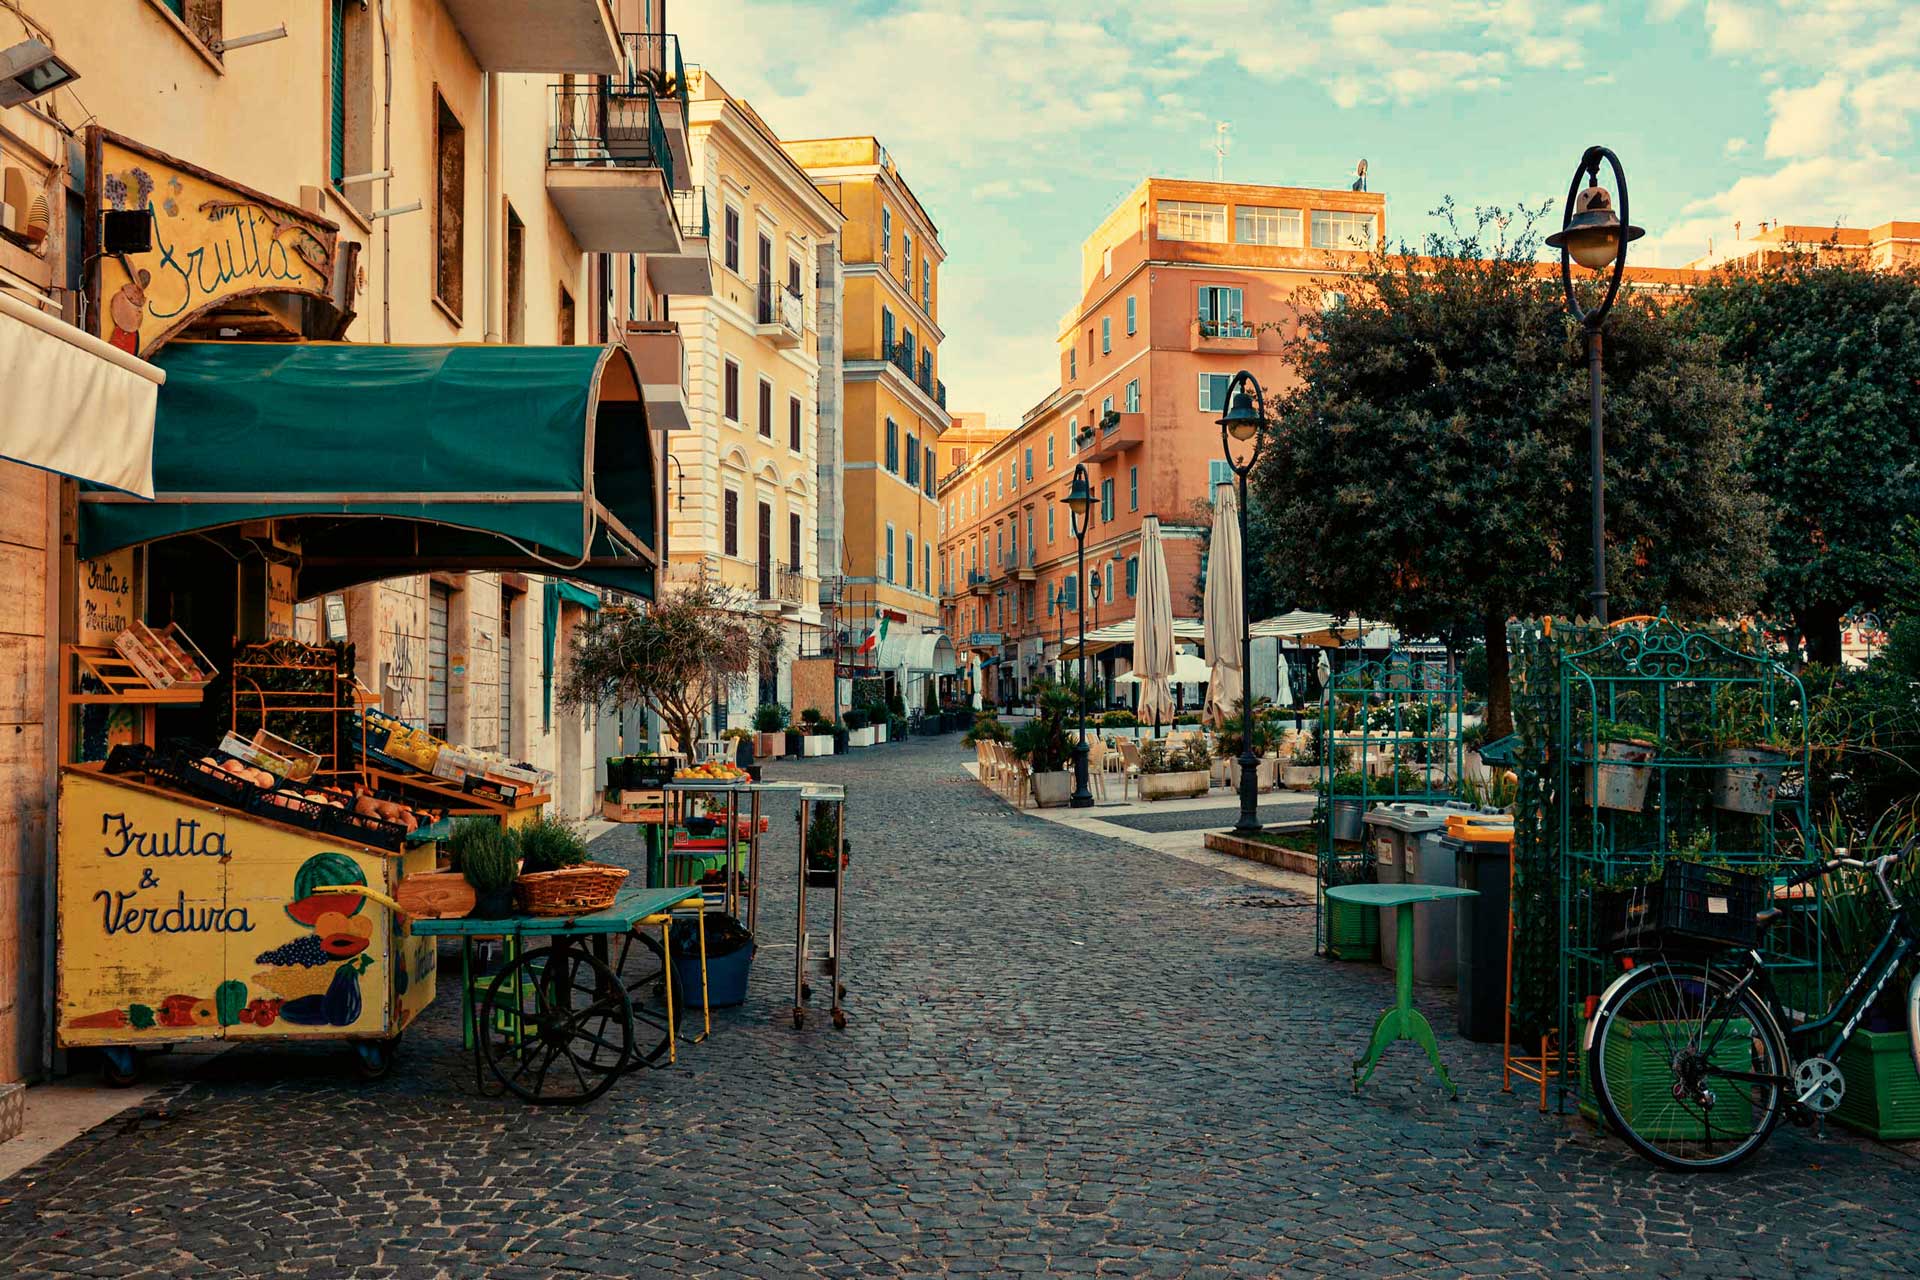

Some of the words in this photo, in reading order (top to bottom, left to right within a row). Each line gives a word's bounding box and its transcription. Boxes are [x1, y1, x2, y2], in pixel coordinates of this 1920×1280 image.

[88, 560, 119, 593] Frutta
[121, 576, 129, 594] &
[103, 813, 232, 857] Frutta
[139, 868, 160, 889] &
[93, 889, 256, 935] Verdura
[1842, 959, 1899, 1040] Frera
